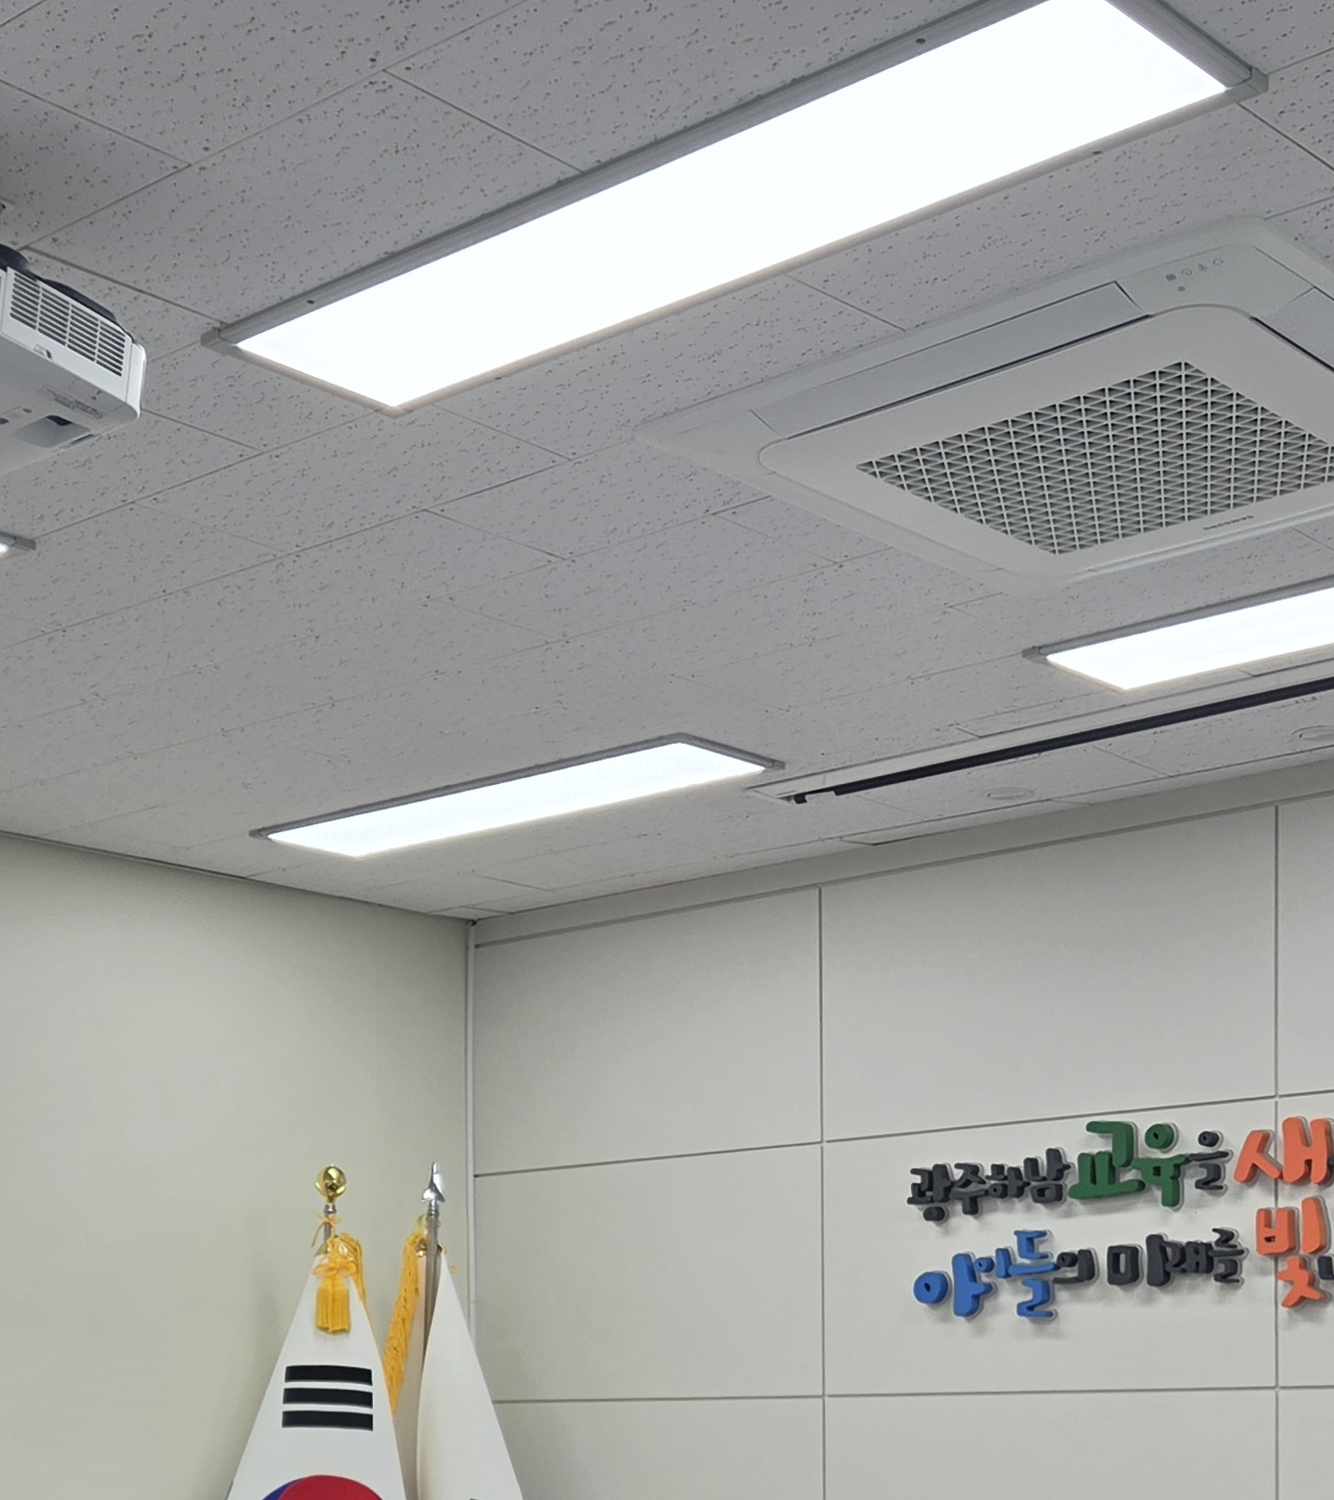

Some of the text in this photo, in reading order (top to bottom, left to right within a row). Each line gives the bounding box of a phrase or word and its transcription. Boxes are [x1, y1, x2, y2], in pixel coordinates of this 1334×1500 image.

[906, 1147, 1070, 1221] 광주하남
[1067, 1120, 1230, 1208] 교육을
[913, 1229, 1097, 1318] 아이들의
[1107, 1227, 1246, 1287] 미래를
